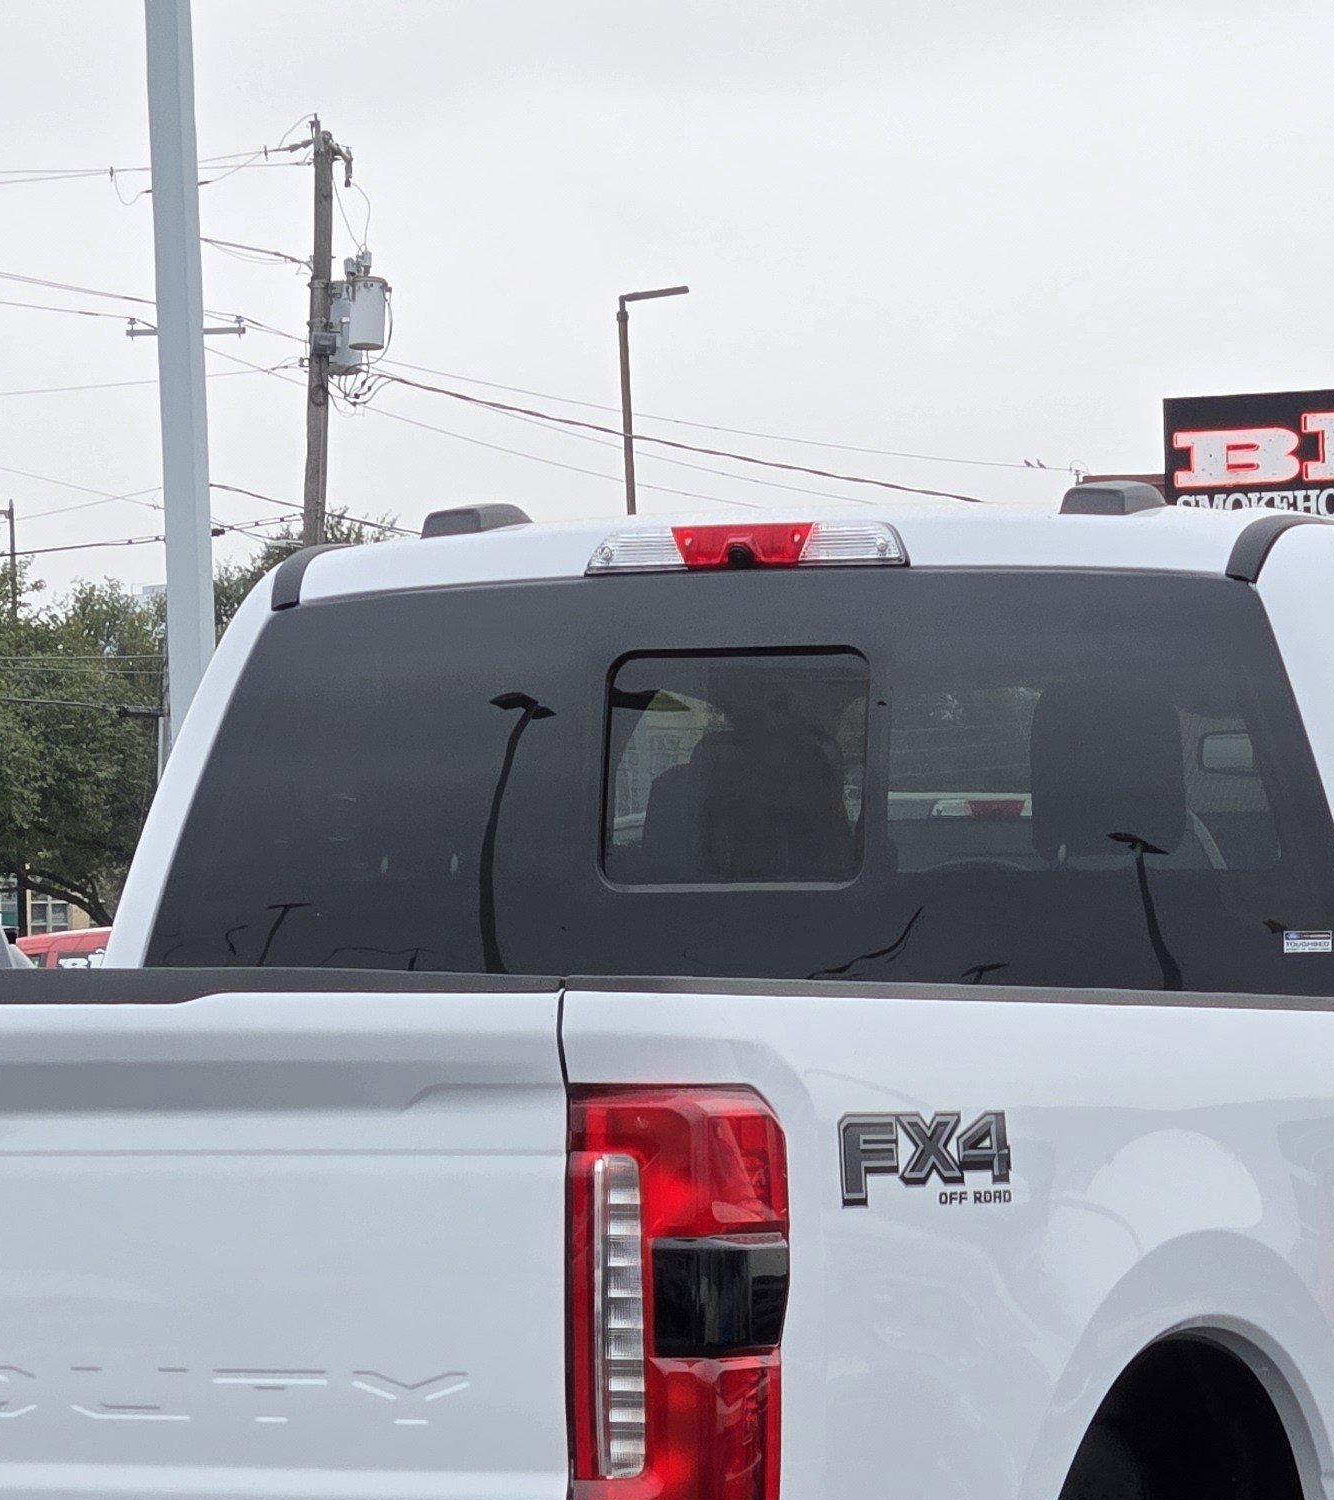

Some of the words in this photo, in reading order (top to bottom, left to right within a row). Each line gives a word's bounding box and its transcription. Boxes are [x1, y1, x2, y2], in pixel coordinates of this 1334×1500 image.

[837, 1110, 1012, 1209] FX4
[938, 1190, 968, 1206] OFF
[973, 1189, 1013, 1205] ROAD
